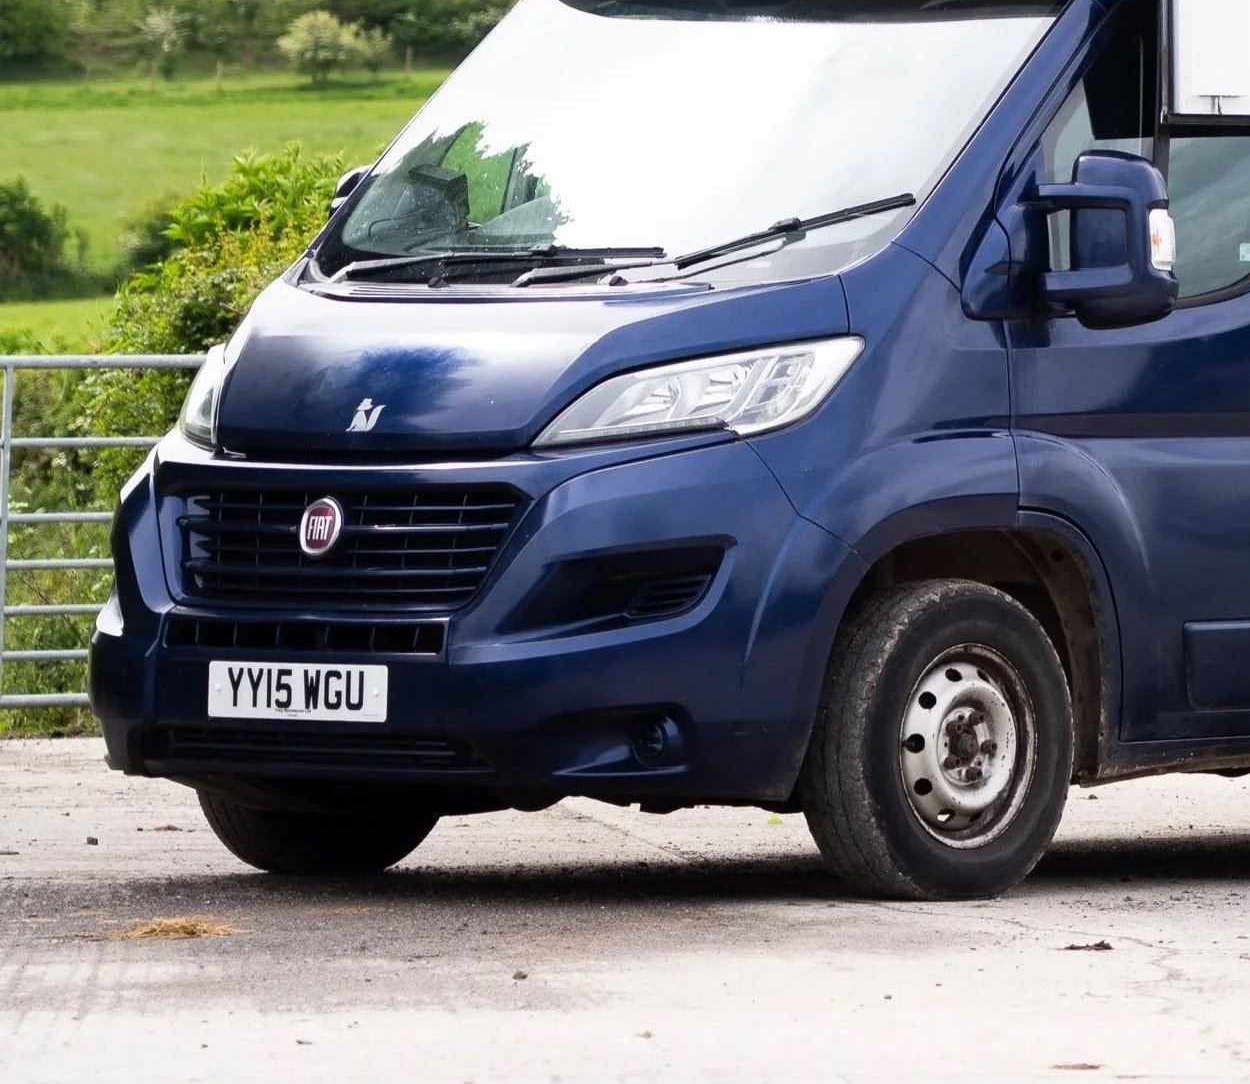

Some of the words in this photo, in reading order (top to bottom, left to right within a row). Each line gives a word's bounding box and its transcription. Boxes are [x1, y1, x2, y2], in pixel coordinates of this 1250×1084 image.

[307, 516, 333, 540] FIAT
[228, 667, 292, 709] YY15
[304, 669, 365, 711] WGU
